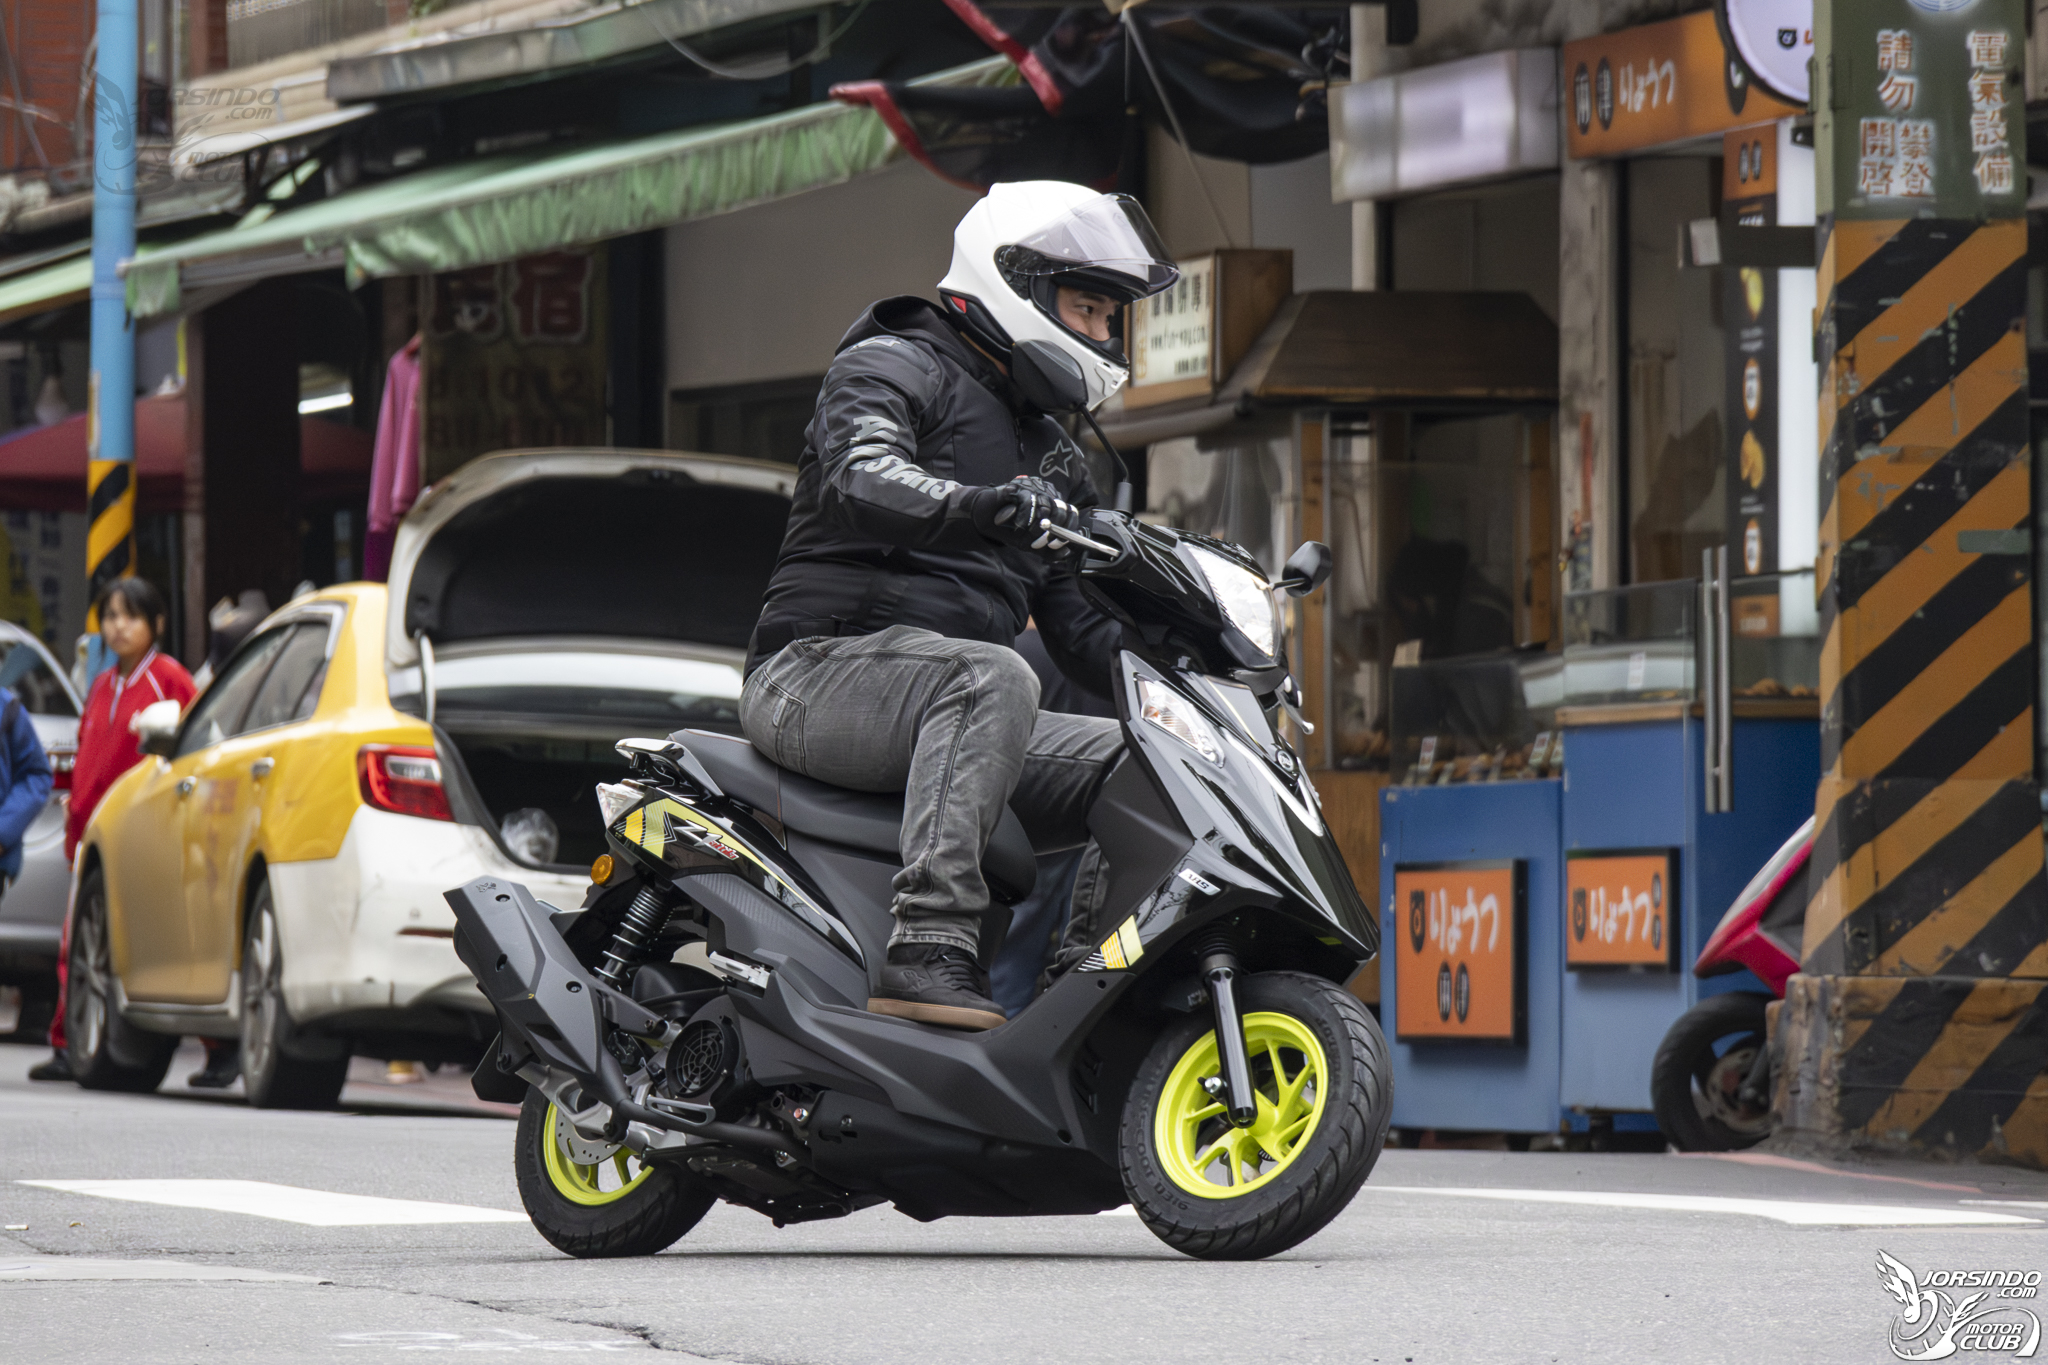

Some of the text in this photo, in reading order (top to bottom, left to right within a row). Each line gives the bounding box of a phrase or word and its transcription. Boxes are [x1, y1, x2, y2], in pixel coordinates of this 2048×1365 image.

[1878, 31, 1915, 111] 請勿
[1970, 30, 2012, 190] 電氣設備
[1899, 122, 1932, 198] 攀登
[1430, 886, 1498, 955] りょうつ
[1590, 885, 1650, 944] りょうつ
